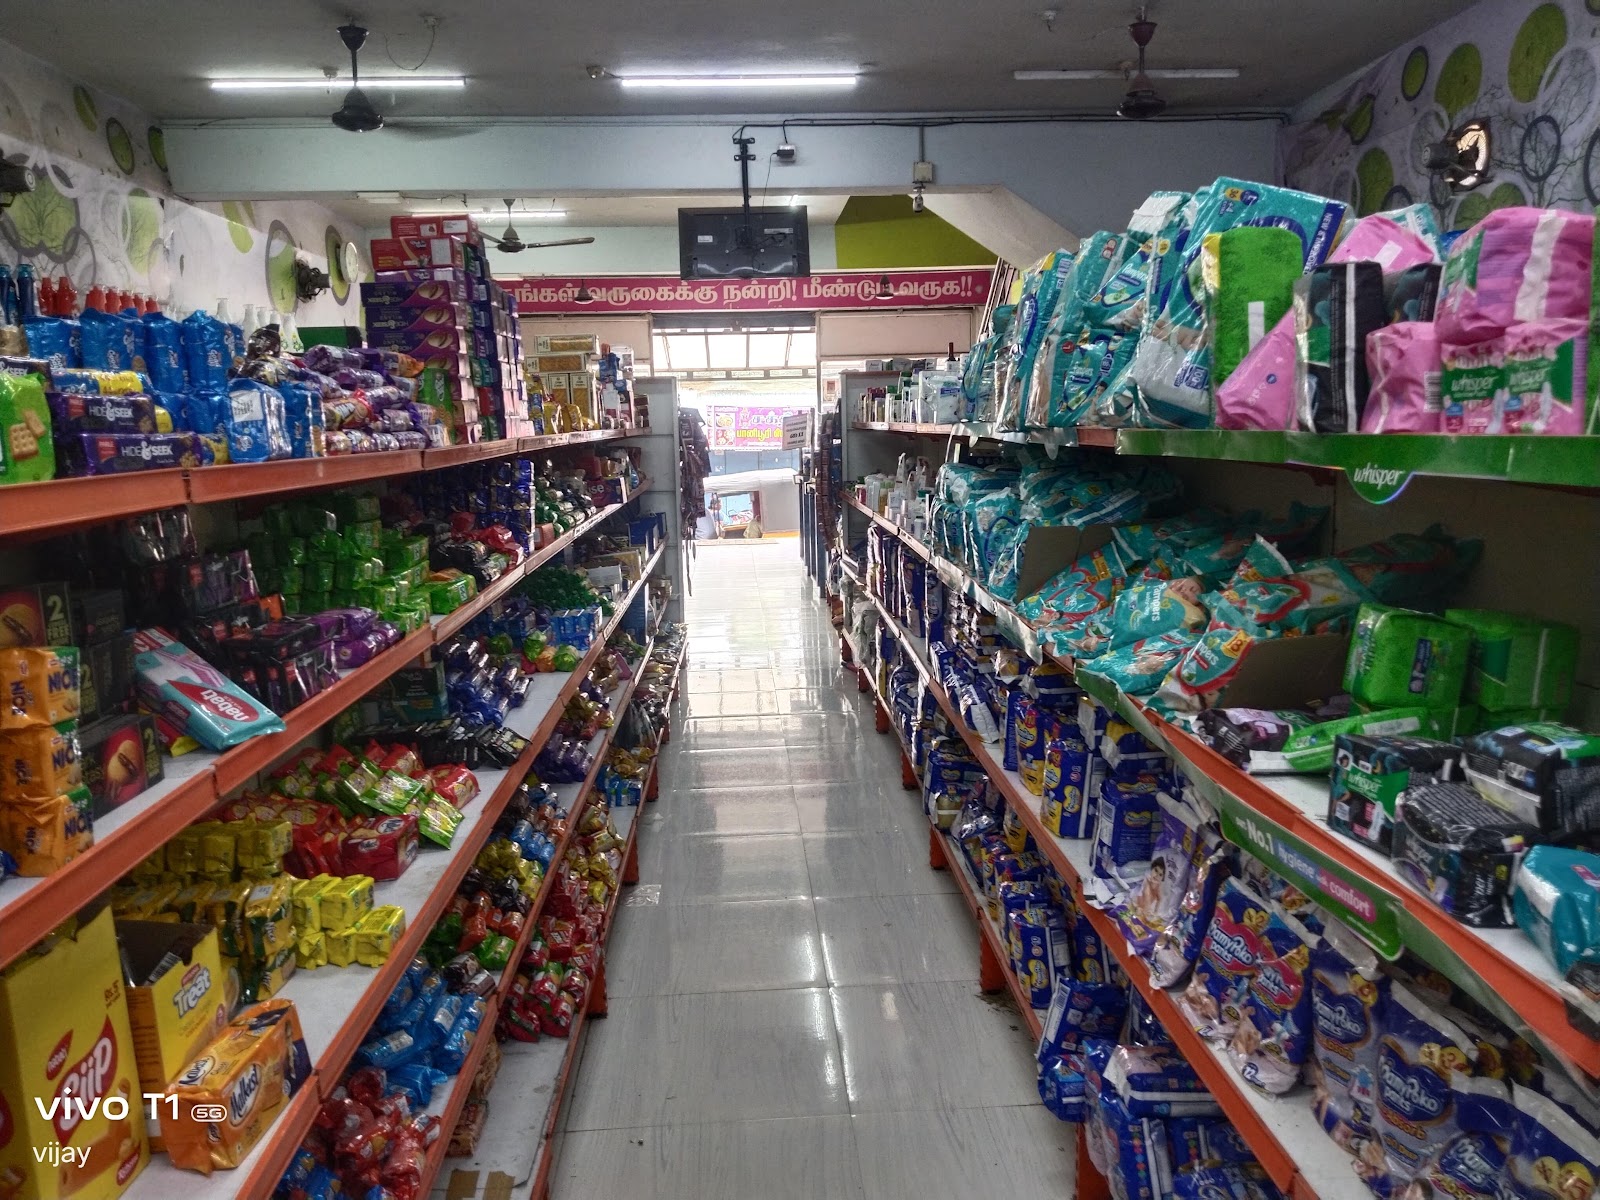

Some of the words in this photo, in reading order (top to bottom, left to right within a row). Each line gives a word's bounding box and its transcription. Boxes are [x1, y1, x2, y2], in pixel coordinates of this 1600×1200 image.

[1321, 212, 1333, 231] NEW
[588, 280, 718, 306] வருகைக்கு
[898, 275, 972, 300] வருக!!
[1451, 373, 1499, 394] whisper
[88, 402, 134, 421] HIDE&SEEK
[121, 440, 174, 461] HIDE&SEEK
[1353, 461, 1406, 490] whisper
[1152, 582, 1167, 622] Pampers
[200, 689, 250, 721] nabati
[1347, 772, 1383, 794] whisper
[1246, 819, 1275, 855] No.1
[1278, 843, 1315, 878] hygiene
[1328, 881, 1371, 917] comfort
[1210, 941, 1232, 964] pants
[173, 966, 212, 1018] Treat
[1381, 1065, 1439, 1111] MamyPoko
[1384, 1086, 1411, 1112] pants
